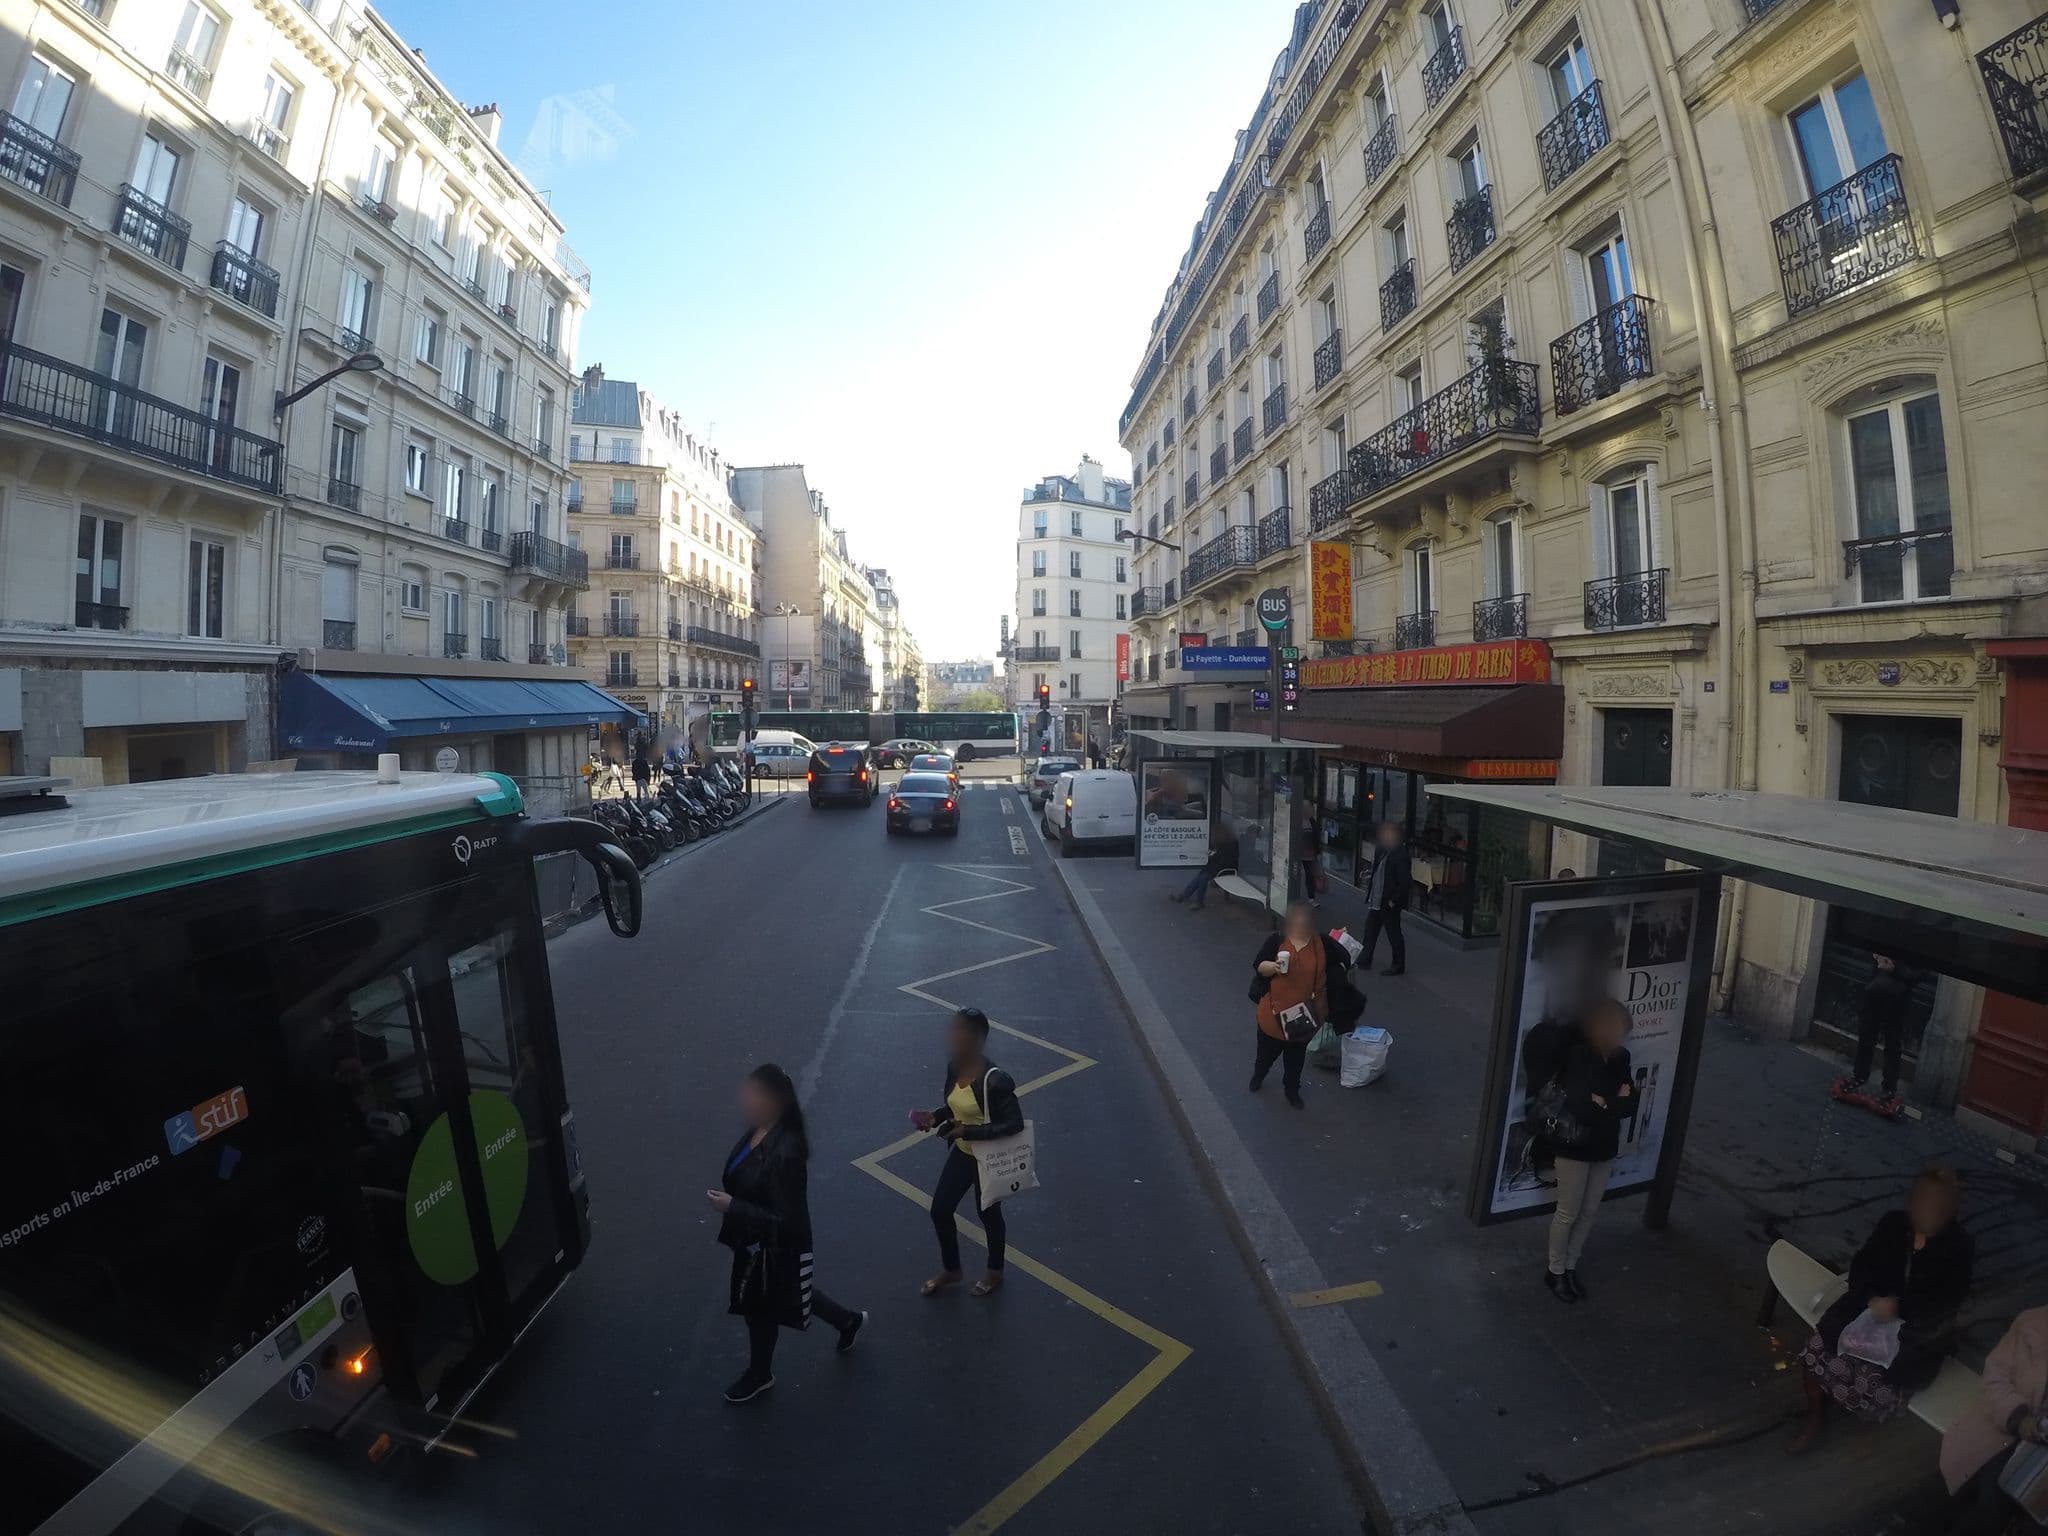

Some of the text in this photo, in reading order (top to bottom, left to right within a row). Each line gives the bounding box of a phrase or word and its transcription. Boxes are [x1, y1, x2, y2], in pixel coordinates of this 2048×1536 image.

[1262, 599, 1287, 612] BUS
[1185, 655, 1195, 663] La
[1195, 655, 1222, 665] Fayette
[1228, 654, 1267, 664] Dunkerque
[1284, 648, 1296, 658] 35
[1119, 660, 1128, 674] ibis
[1400, 647, 1513, 681] LE JUMBO DE PARIS
[1284, 670, 1297, 680] 38
[1284, 691, 1297, 701] 39
[333, 735, 376, 747] Restaurant
[1478, 761, 1555, 777] RESTAURANT
[473, 836, 498, 850] RATP
[1624, 970, 1682, 1003] Dior
[199, 1085, 244, 1132] stif
[484, 1127, 517, 1161] Entrée
[52, 1200, 72, 1219] en
[71, 1153, 161, 1208] Île-de-France
[414, 1179, 454, 1218] Entrée
